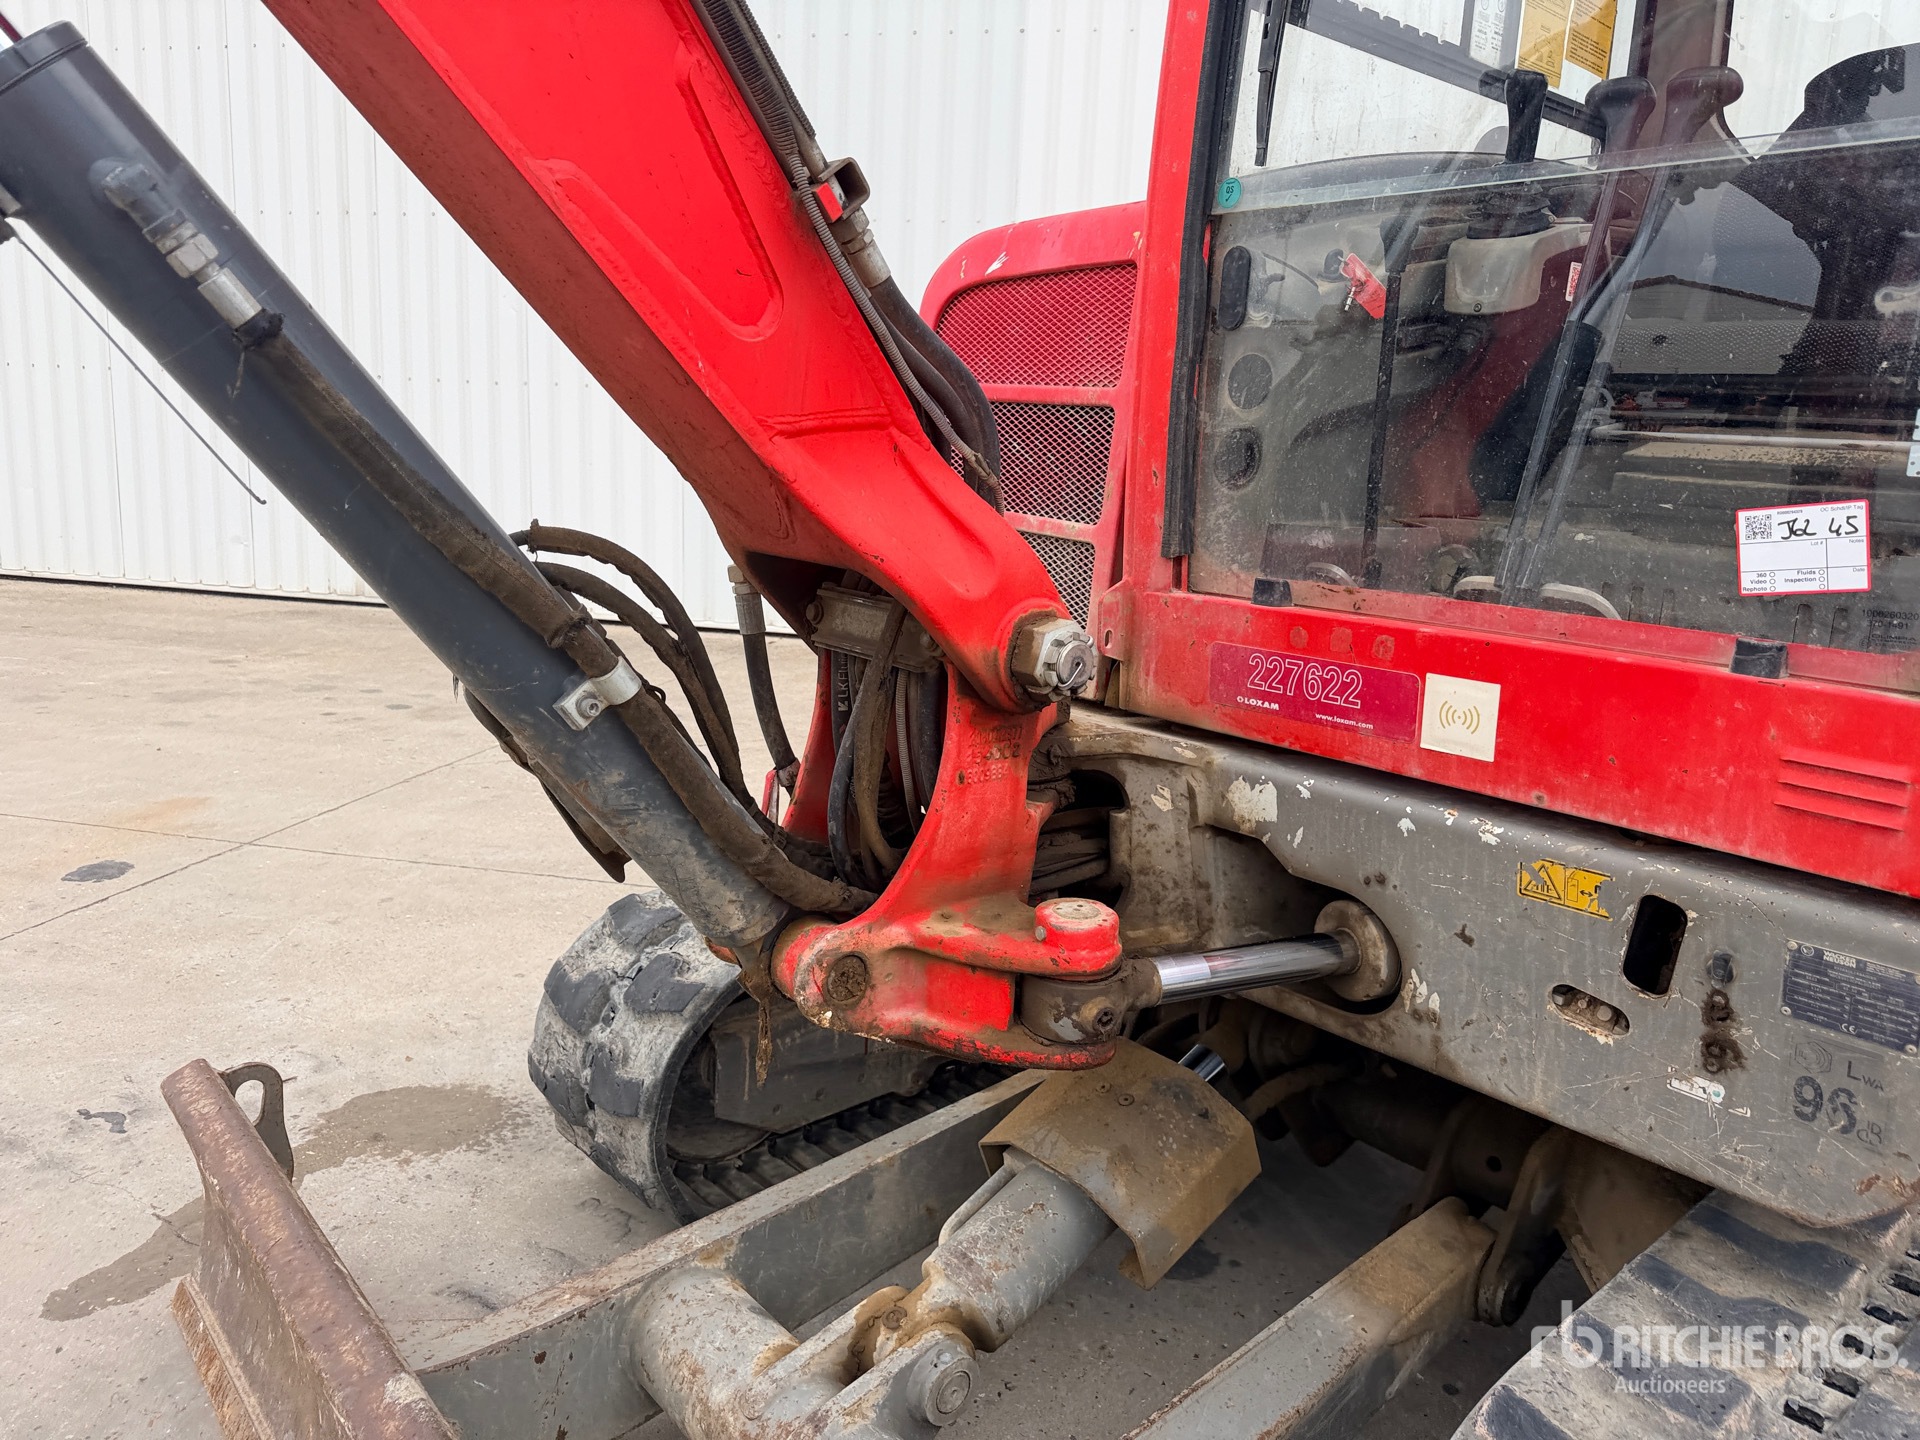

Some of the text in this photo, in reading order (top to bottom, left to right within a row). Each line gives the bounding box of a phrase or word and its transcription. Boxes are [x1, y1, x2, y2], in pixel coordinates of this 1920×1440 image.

[1225, 185, 1235, 194] QS
[1828, 515, 1859, 537] 45
[1247, 653, 1362, 709] 227622
[1244, 697, 1280, 711] LOXAM
[1315, 713, 1374, 730] www.loxam.com
[1823, 949, 1856, 963] WACKER
[1823, 955, 1857, 969] NEUSON
[1792, 1075, 1858, 1135] 96
